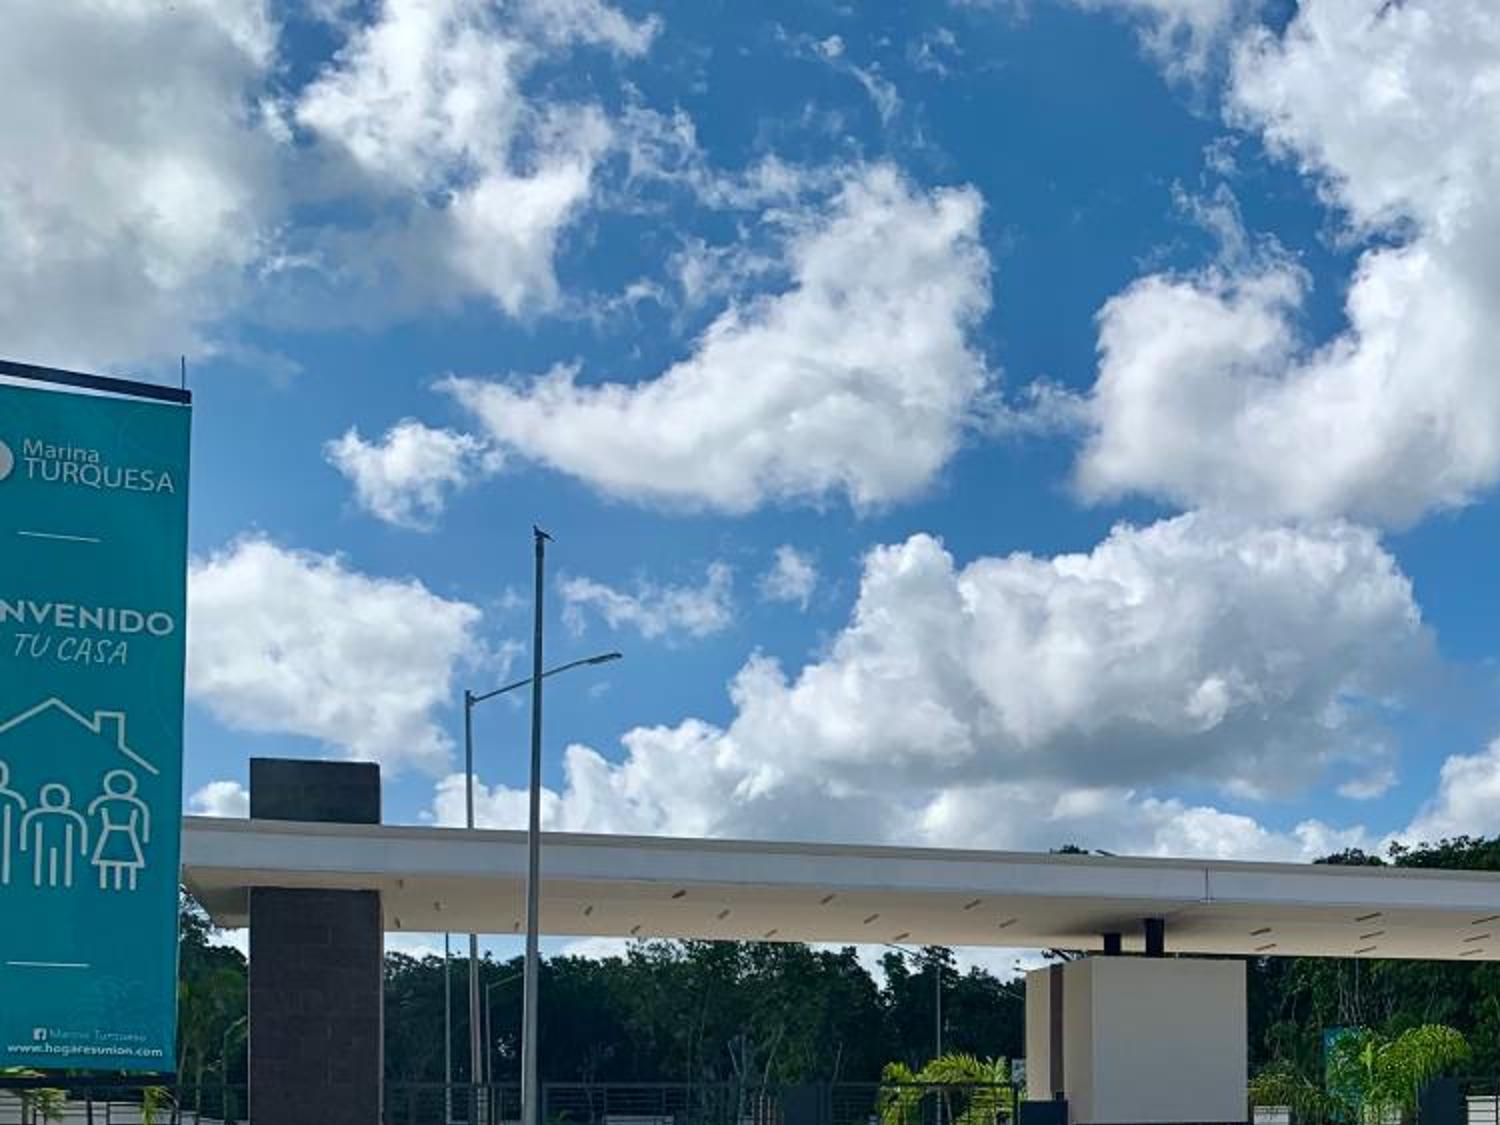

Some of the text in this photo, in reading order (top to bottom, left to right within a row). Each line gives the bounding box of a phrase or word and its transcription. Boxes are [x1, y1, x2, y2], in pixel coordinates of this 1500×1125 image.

[23, 438, 99, 463] Marina
[23, 457, 175, 493] TURQUESA
[15, 633, 128, 665] TU CASA
